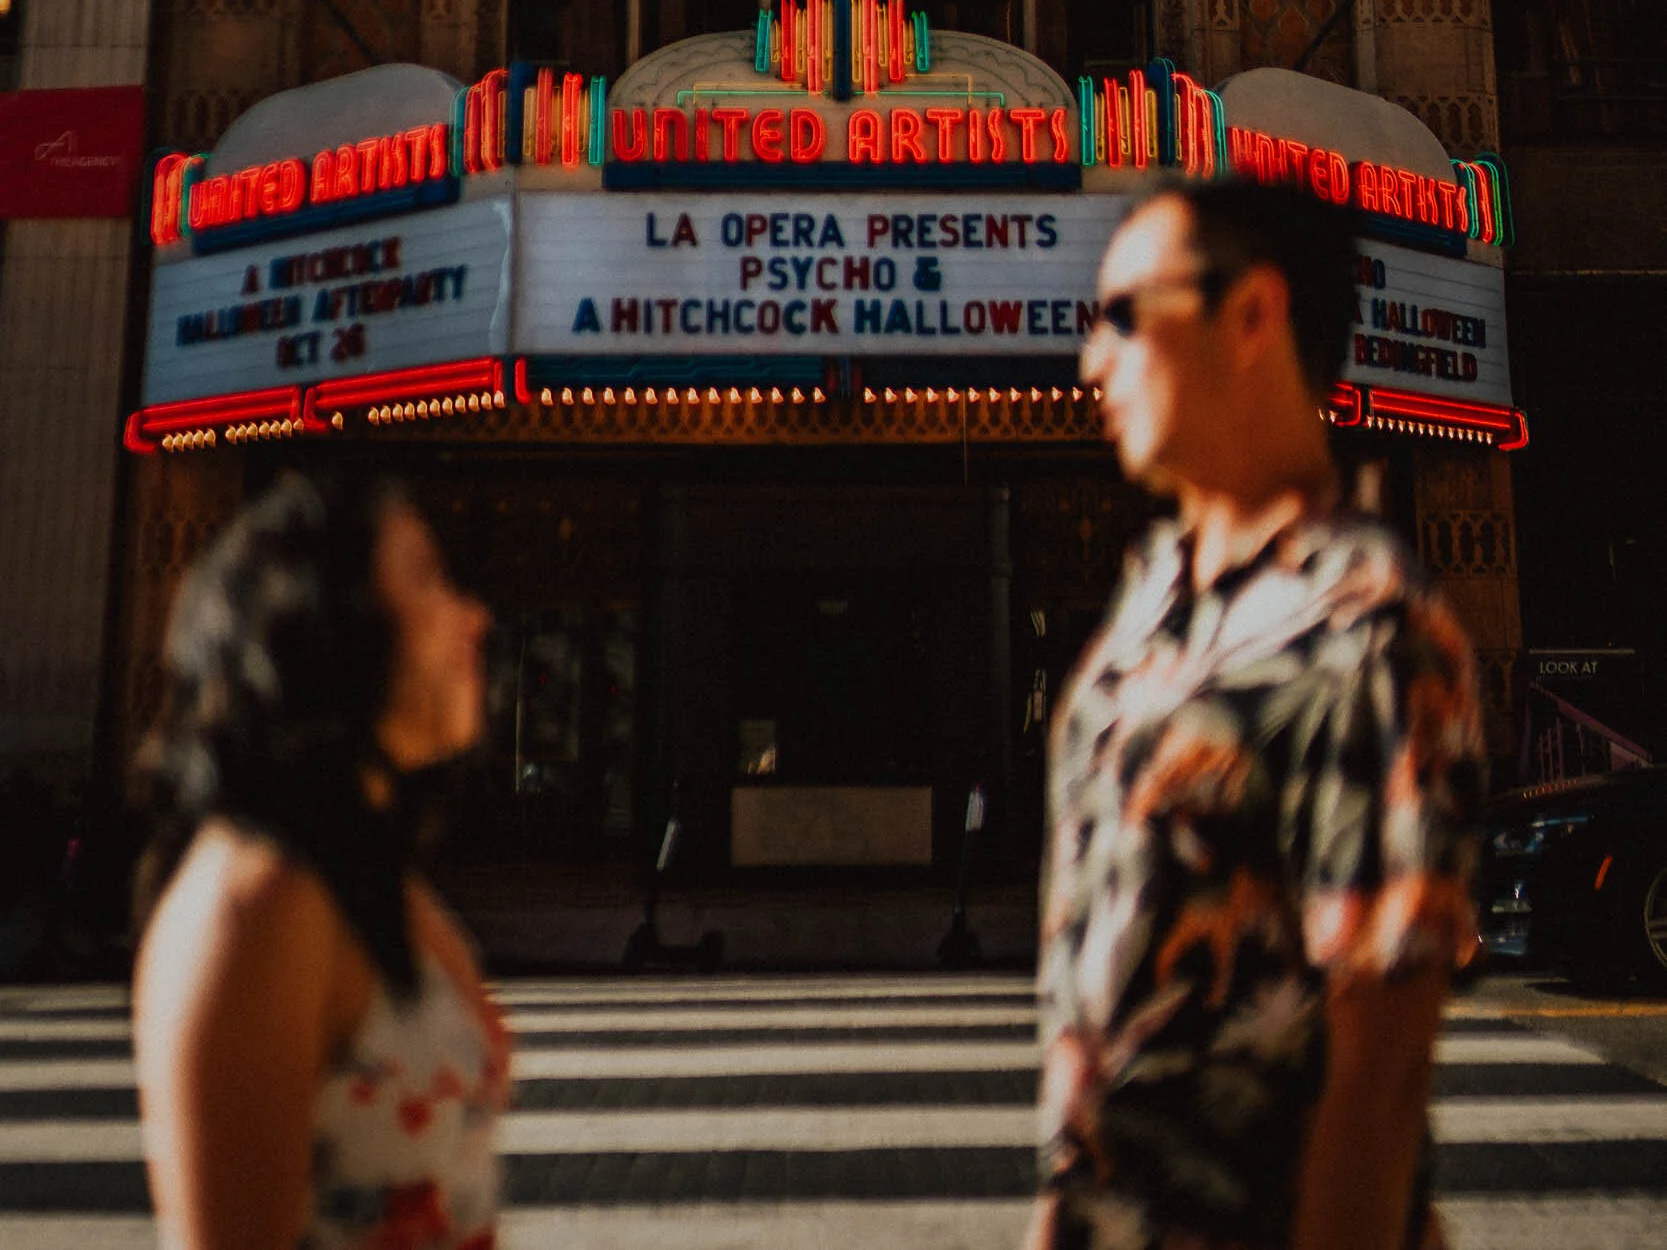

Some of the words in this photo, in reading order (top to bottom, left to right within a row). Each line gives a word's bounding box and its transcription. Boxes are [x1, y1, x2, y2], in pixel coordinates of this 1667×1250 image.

[611, 108, 825, 163] UNITED
[848, 108, 1071, 163] ARTISTS
[189, 158, 309, 230] UNITED
[310, 124, 449, 205] ARTISTS
[1352, 160, 1468, 233] ARTISTS
[646, 213, 698, 247] LA
[722, 213, 845, 248] OPERA
[867, 213, 1058, 248] PRESENTS
[241, 264, 259, 295] A
[269, 236, 401, 289] HITCHCOCK
[740, 256, 897, 291] PSYCHO
[913, 257, 942, 291] &
[176, 295, 302, 347] HALLOWEEN
[313, 264, 466, 321] AFTERPARTY
[572, 299, 601, 334] A
[610, 299, 840, 334] HITCHCOCK
[854, 299, 1101, 334] HALLOWEEN
[1371, 298, 1486, 348] HALLOWEEN
[277, 330, 321, 368] OCT
[1539, 661, 1579, 674] LOOK
[1581, 661, 1599, 674] AT
